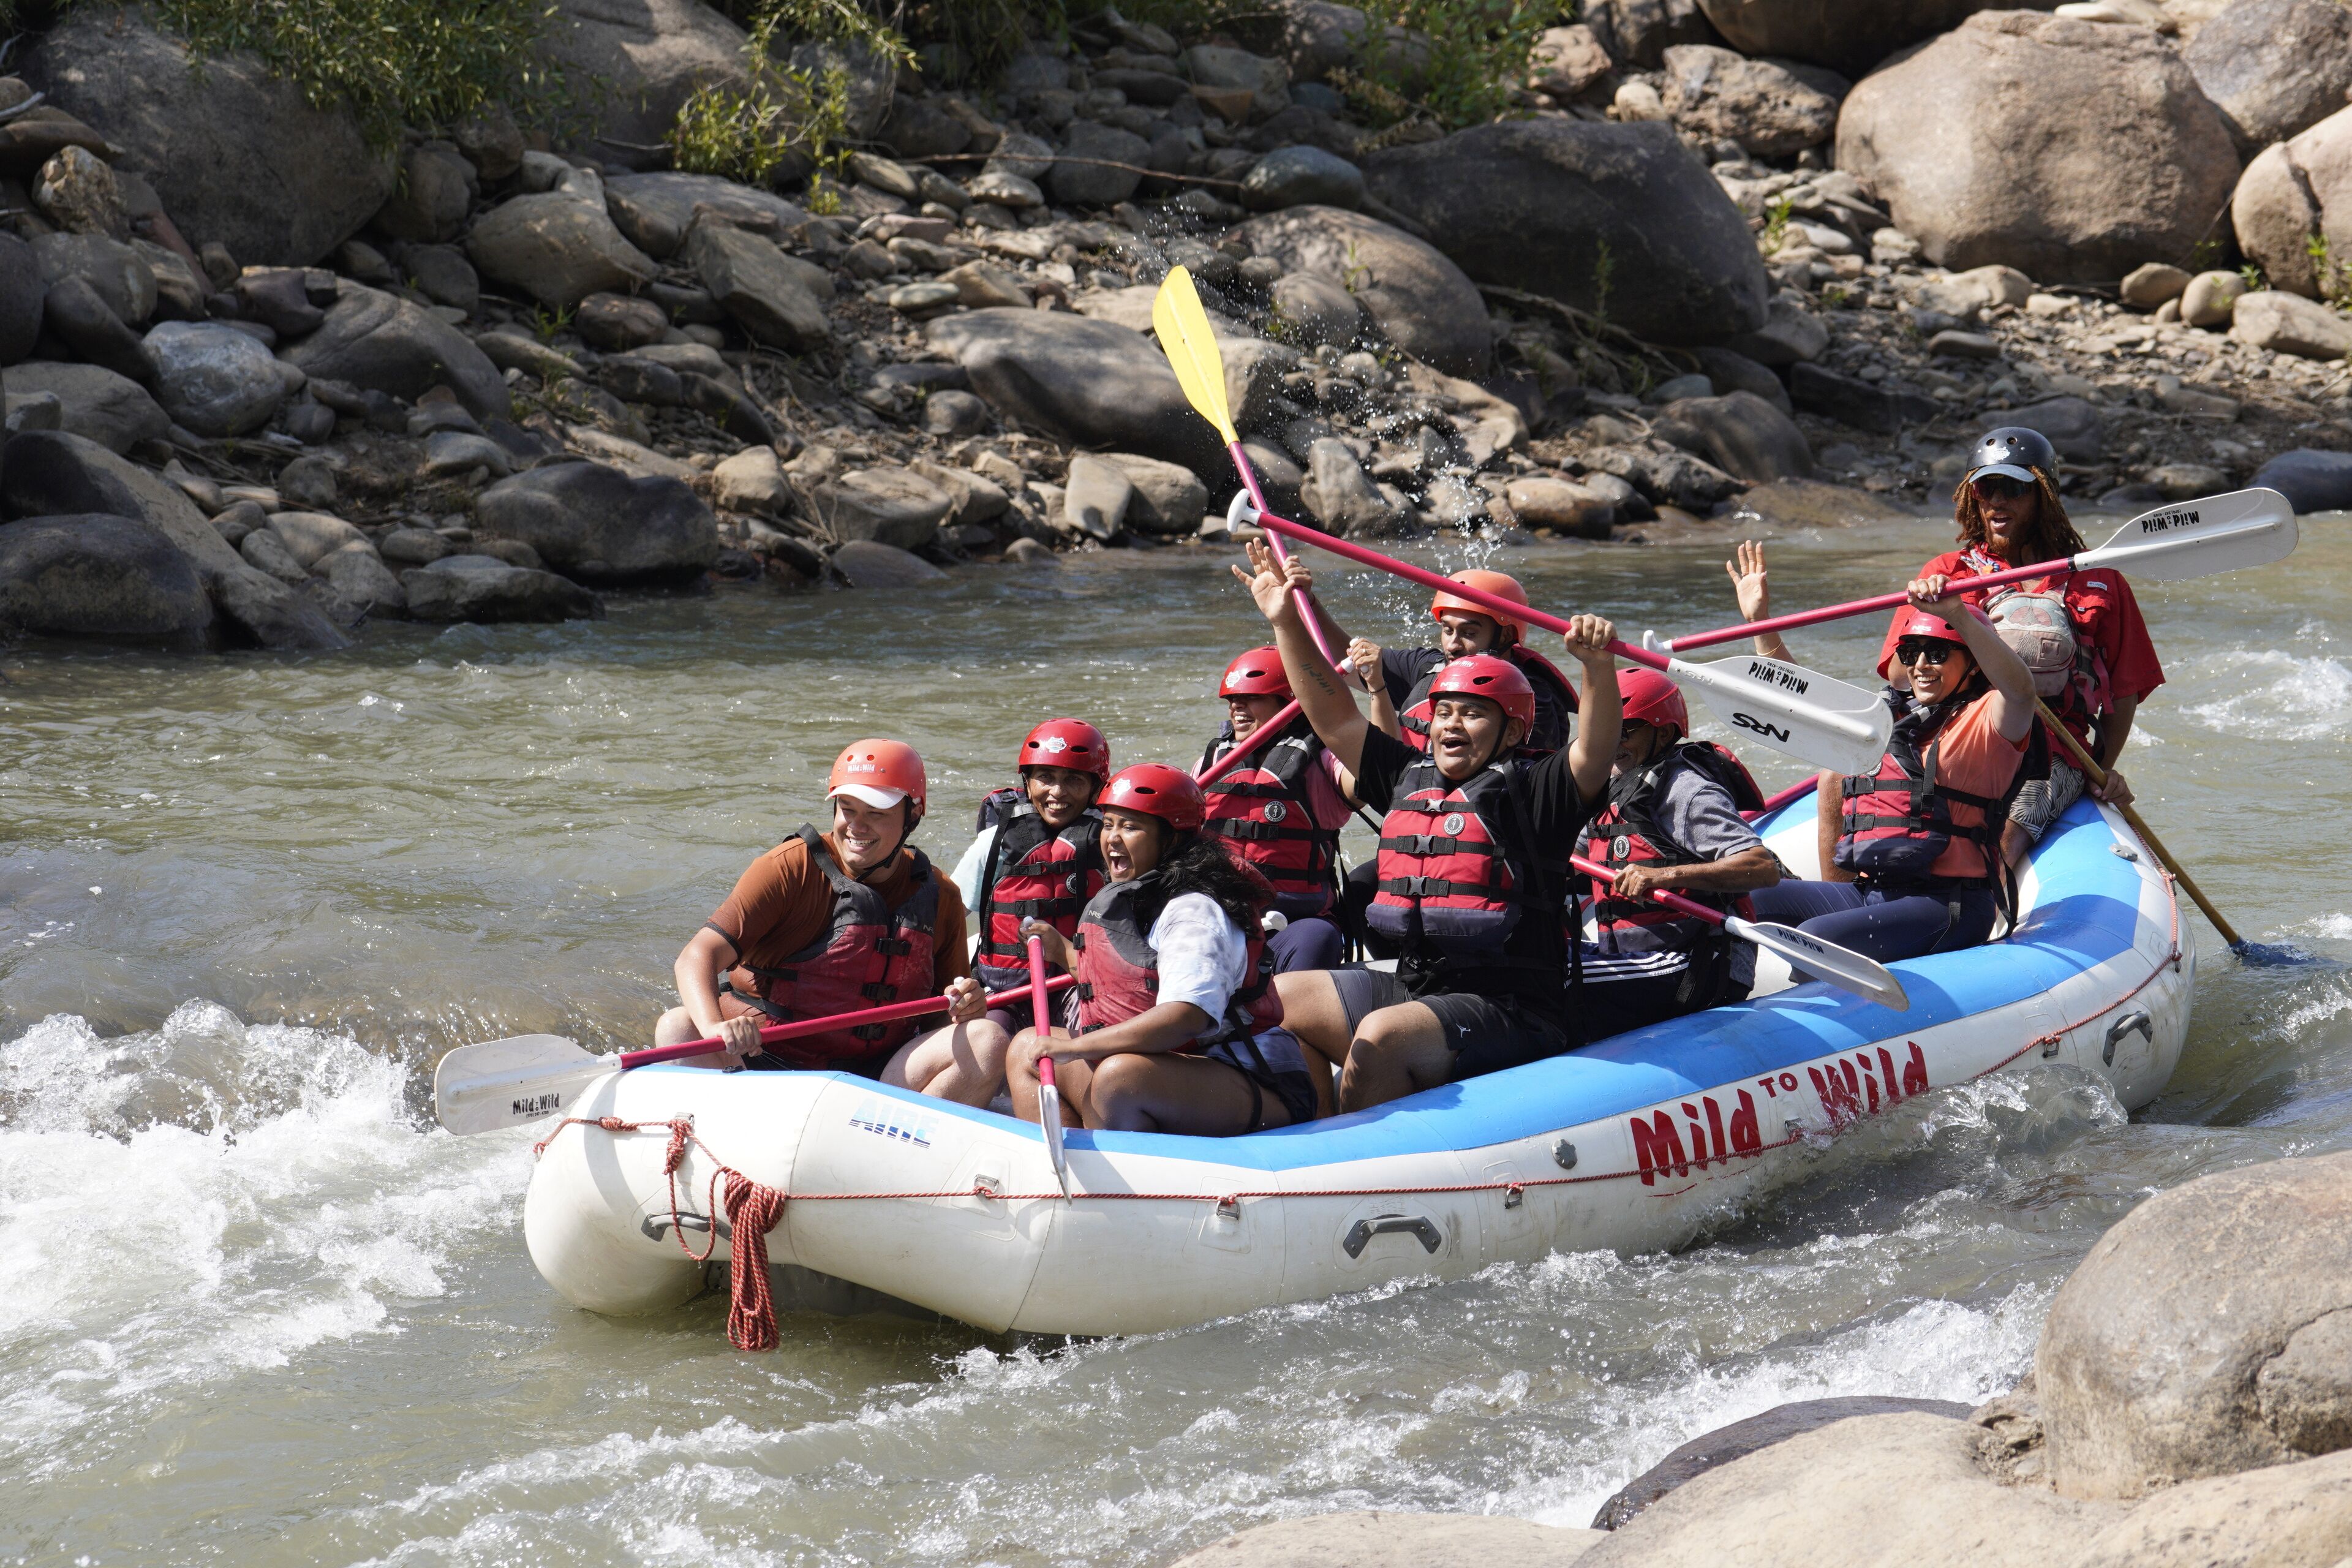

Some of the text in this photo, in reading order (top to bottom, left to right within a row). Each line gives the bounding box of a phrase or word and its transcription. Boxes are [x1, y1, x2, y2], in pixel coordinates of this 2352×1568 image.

[2141, 510, 2199, 533] Mild TO Wild
[1748, 662, 1809, 695] Mild TO Wild
[1732, 712, 1790, 742] NRS
[862, 764, 875, 772] Wild
[1088, 910, 1102, 919] NRS
[922, 924, 935, 935] NR
[1777, 927, 1800, 944] Wild
[1803, 938, 1825, 955] Mild
[513, 1098, 534, 1115] Mild
[539, 1093, 560, 1110] Wild
[1630, 1041, 1929, 1186] Mild TO Wild
[848, 1097, 940, 1149] AIRE
